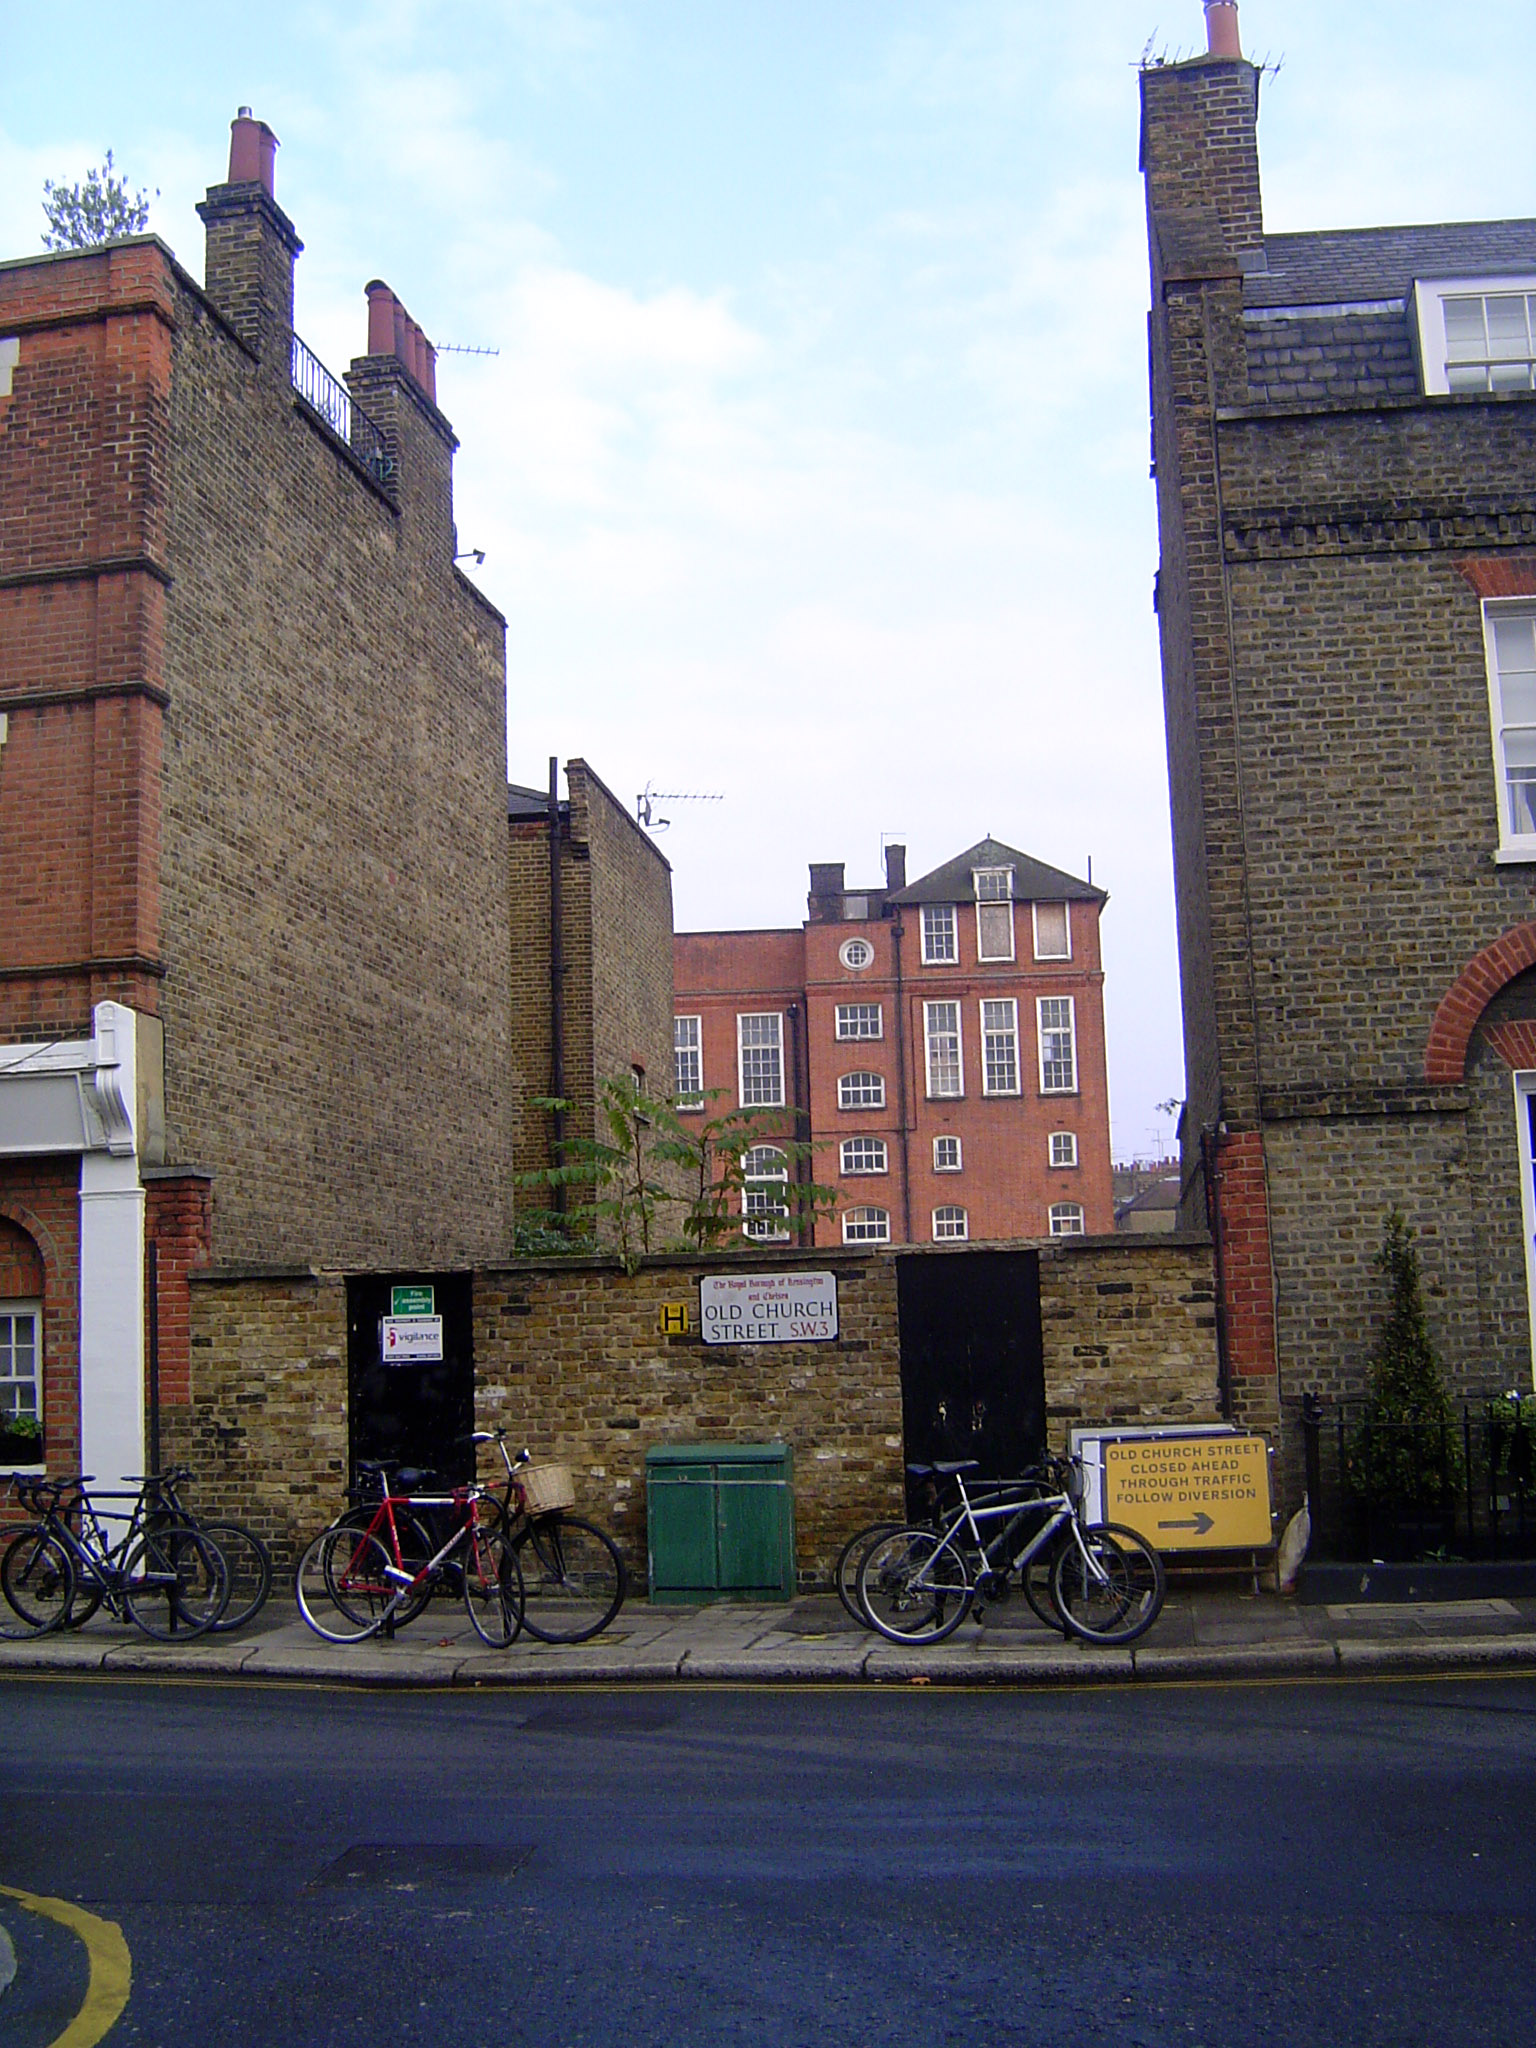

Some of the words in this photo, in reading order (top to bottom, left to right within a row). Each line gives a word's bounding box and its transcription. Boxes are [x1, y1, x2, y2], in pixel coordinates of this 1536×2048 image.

[713, 1280, 726, 1290] The
[728, 1280, 746, 1291] Royal
[749, 1279, 775, 1289] Borough
[778, 1277, 785, 1286] of
[788, 1277, 823, 1288] Kensington
[748, 1293, 760, 1301] and
[763, 1292, 788, 1301] Chelsea
[705, 1304, 742, 1320] OLD
[752, 1301, 833, 1319] CHURCH
[664, 1306, 684, 1331] H
[790, 1321, 829, 1337] S.W.3
[399, 1332, 439, 1343] vigilance
[1109, 1450, 1137, 1461] OLD
[1142, 1447, 1202, 1459] CHURCH
[1207, 1444, 1260, 1457] STREET
[1131, 1462, 1187, 1474] CLOSED
[1191, 1460, 1239, 1472] AHEAD
[1120, 1476, 1189, 1489] THROUGH
[1193, 1474, 1251, 1486] TRAFFIC
[1116, 1492, 1174, 1504] FOLLOW
[1178, 1488, 1256, 1502] DIVERSION
